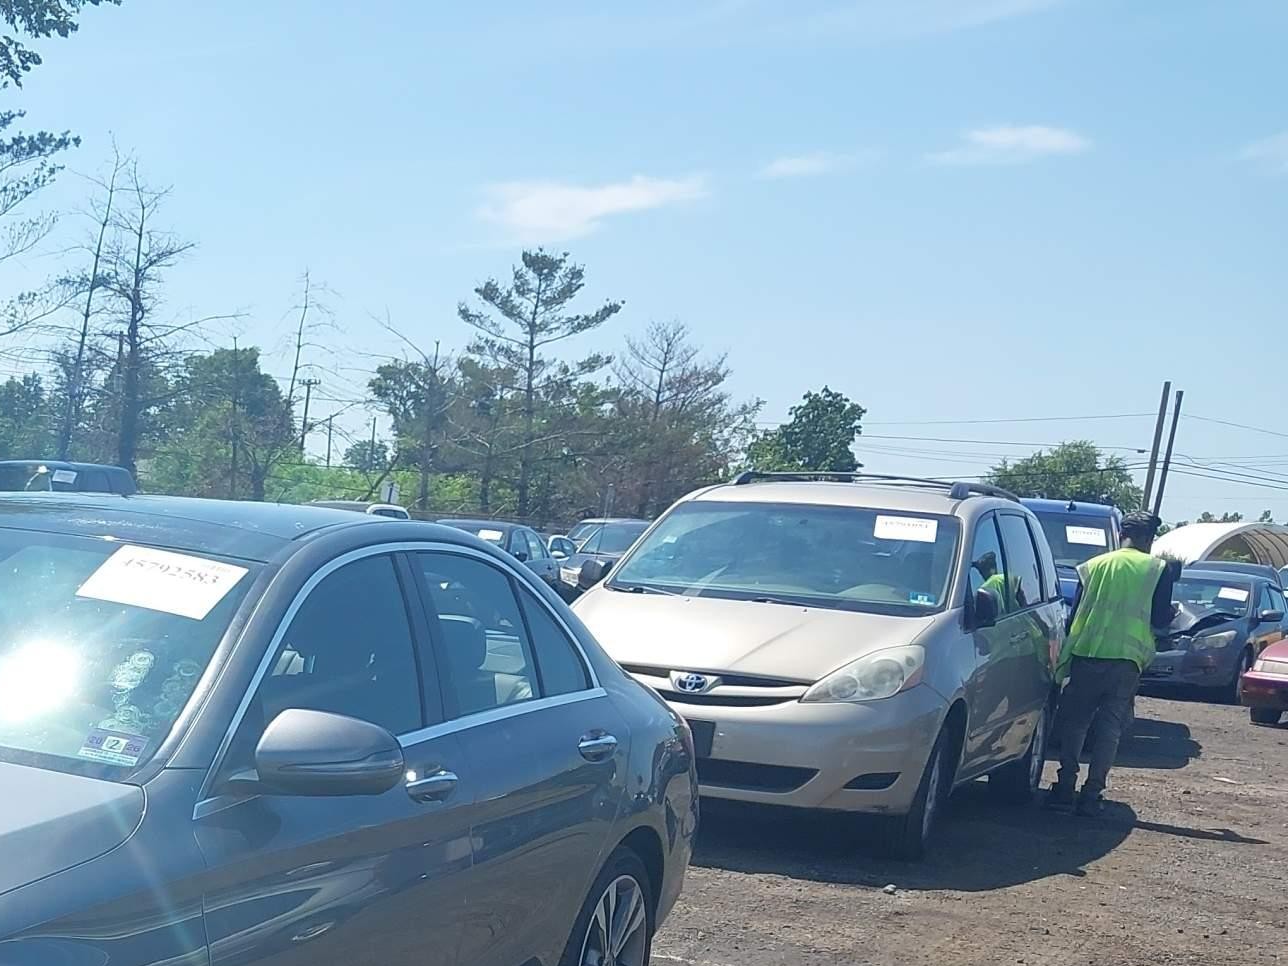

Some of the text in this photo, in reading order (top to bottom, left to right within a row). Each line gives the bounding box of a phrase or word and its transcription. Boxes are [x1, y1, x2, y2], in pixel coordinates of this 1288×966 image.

[88, 735, 141, 753] 20 2 26
